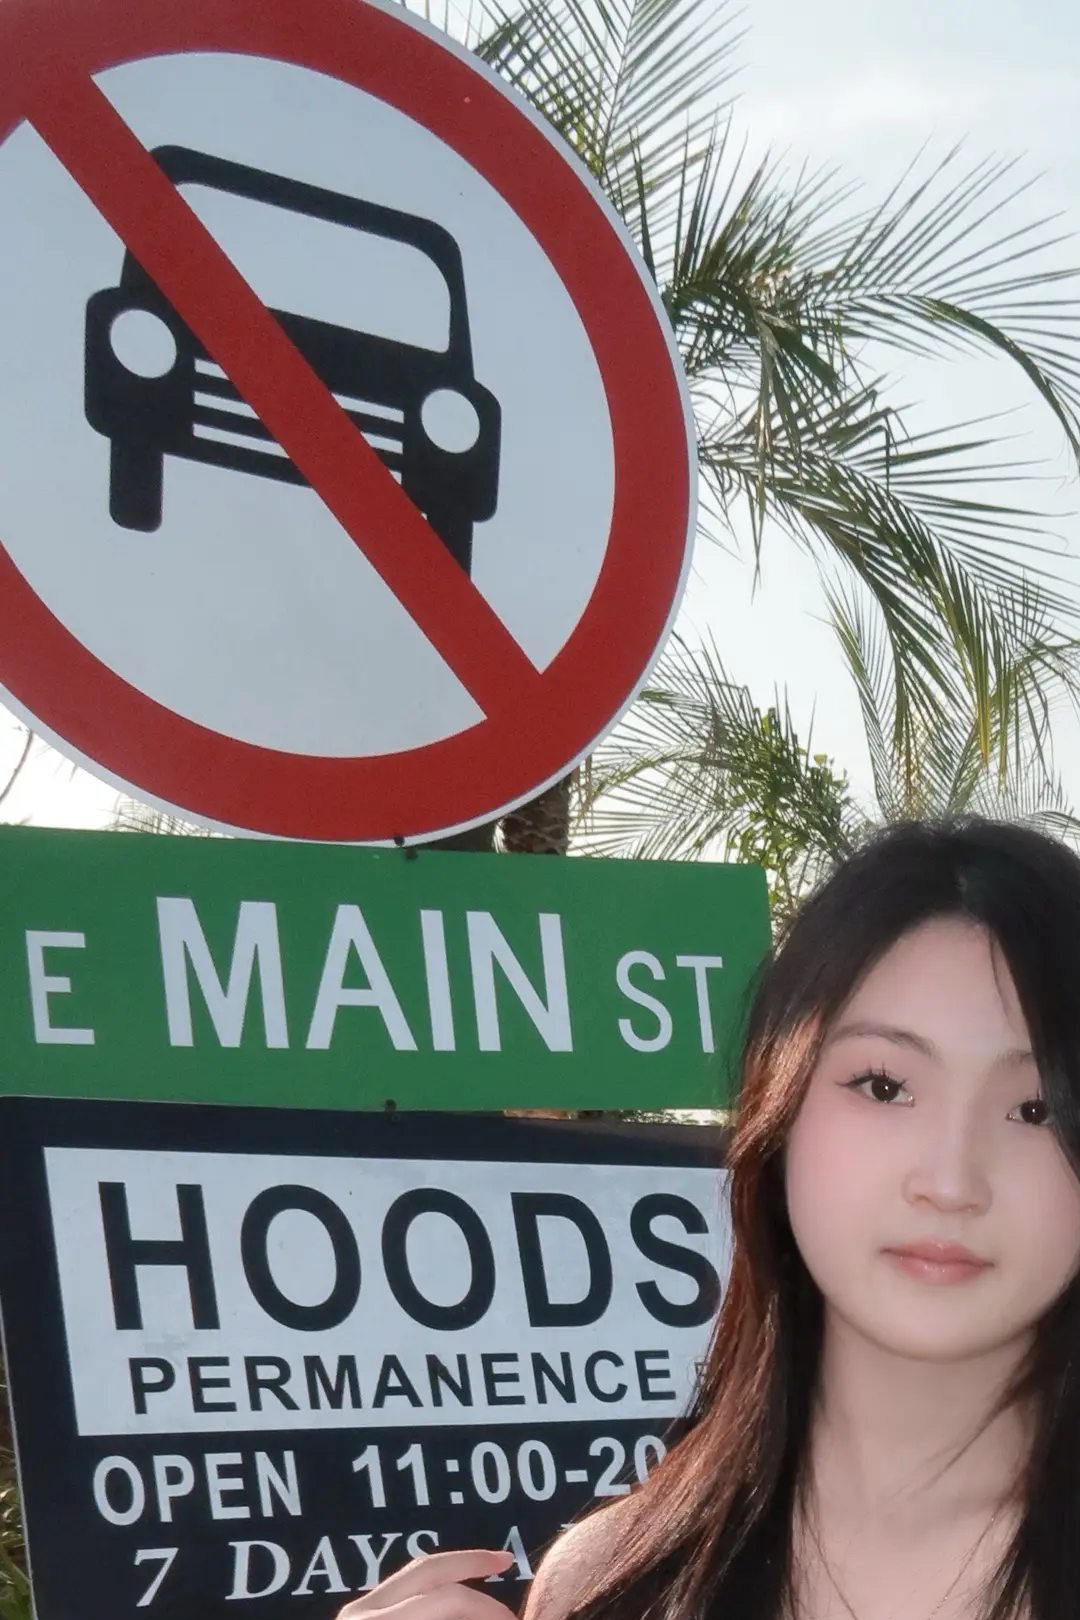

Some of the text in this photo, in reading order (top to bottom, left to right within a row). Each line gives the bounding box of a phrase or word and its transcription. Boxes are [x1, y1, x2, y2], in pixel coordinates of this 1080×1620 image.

[25, 896, 723, 1054] E MAIN ST
[98, 1181, 722, 1332] HOODS
[129, 1349, 677, 1415] PERMANENCE
[92, 1449, 303, 1527] OPEN
[134, 1546, 179, 1607] 7
